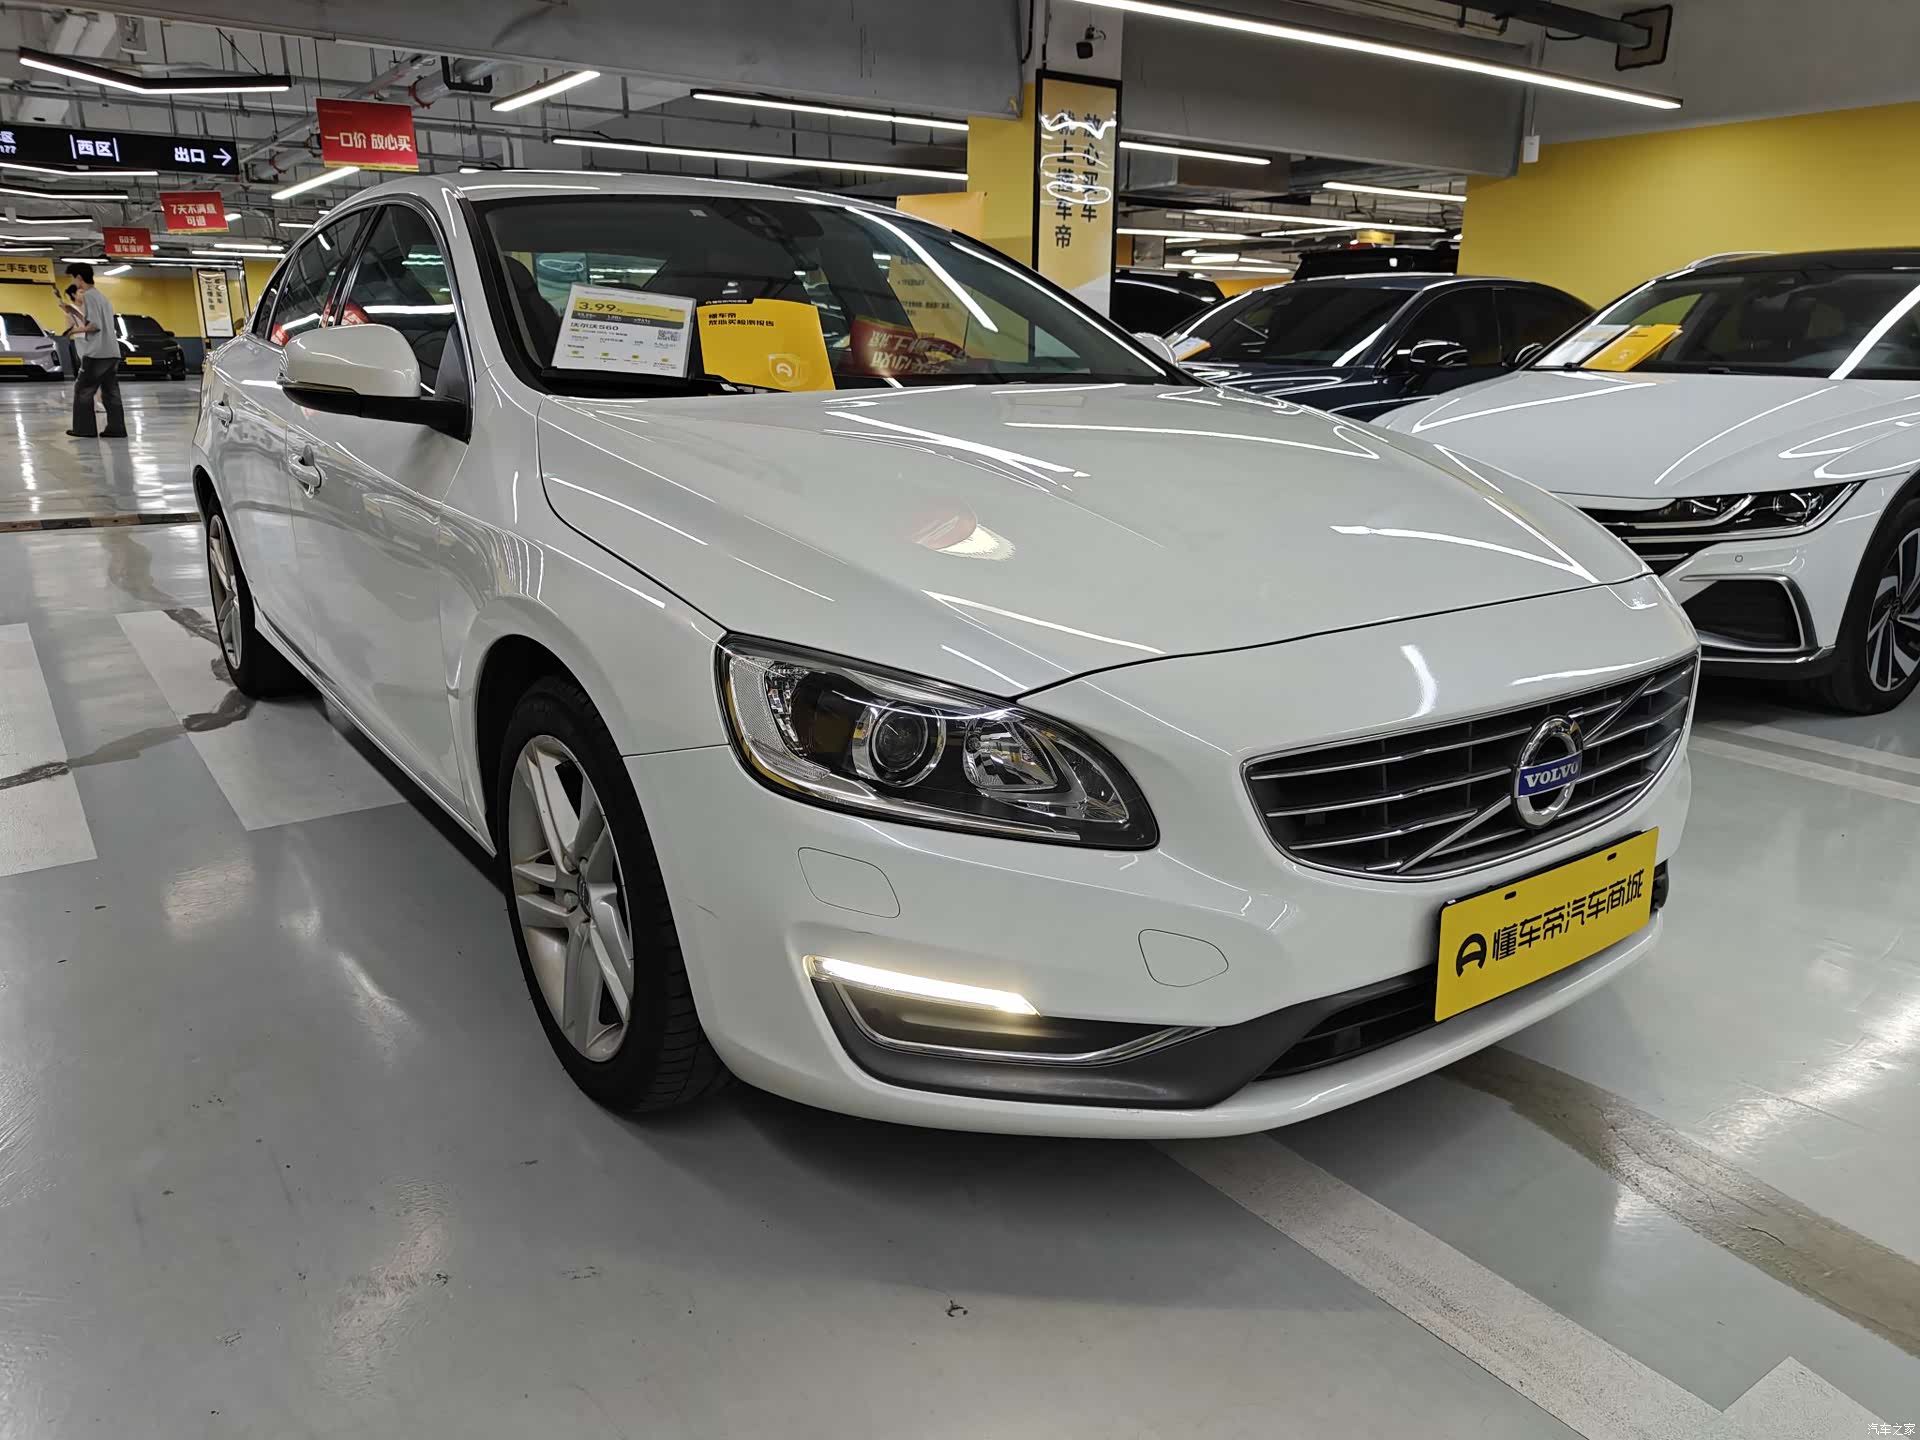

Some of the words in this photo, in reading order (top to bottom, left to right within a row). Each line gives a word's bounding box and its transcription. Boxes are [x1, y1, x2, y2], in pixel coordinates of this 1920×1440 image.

[76, 139, 113, 157] 西区
[324, 131, 367, 149] 一口价
[370, 133, 414, 152] 放心买
[174, 146, 206, 163] 出口
[1523, 763, 1579, 789] VOLVO
[1491, 868, 1645, 962] 懂车帝汽车商城
